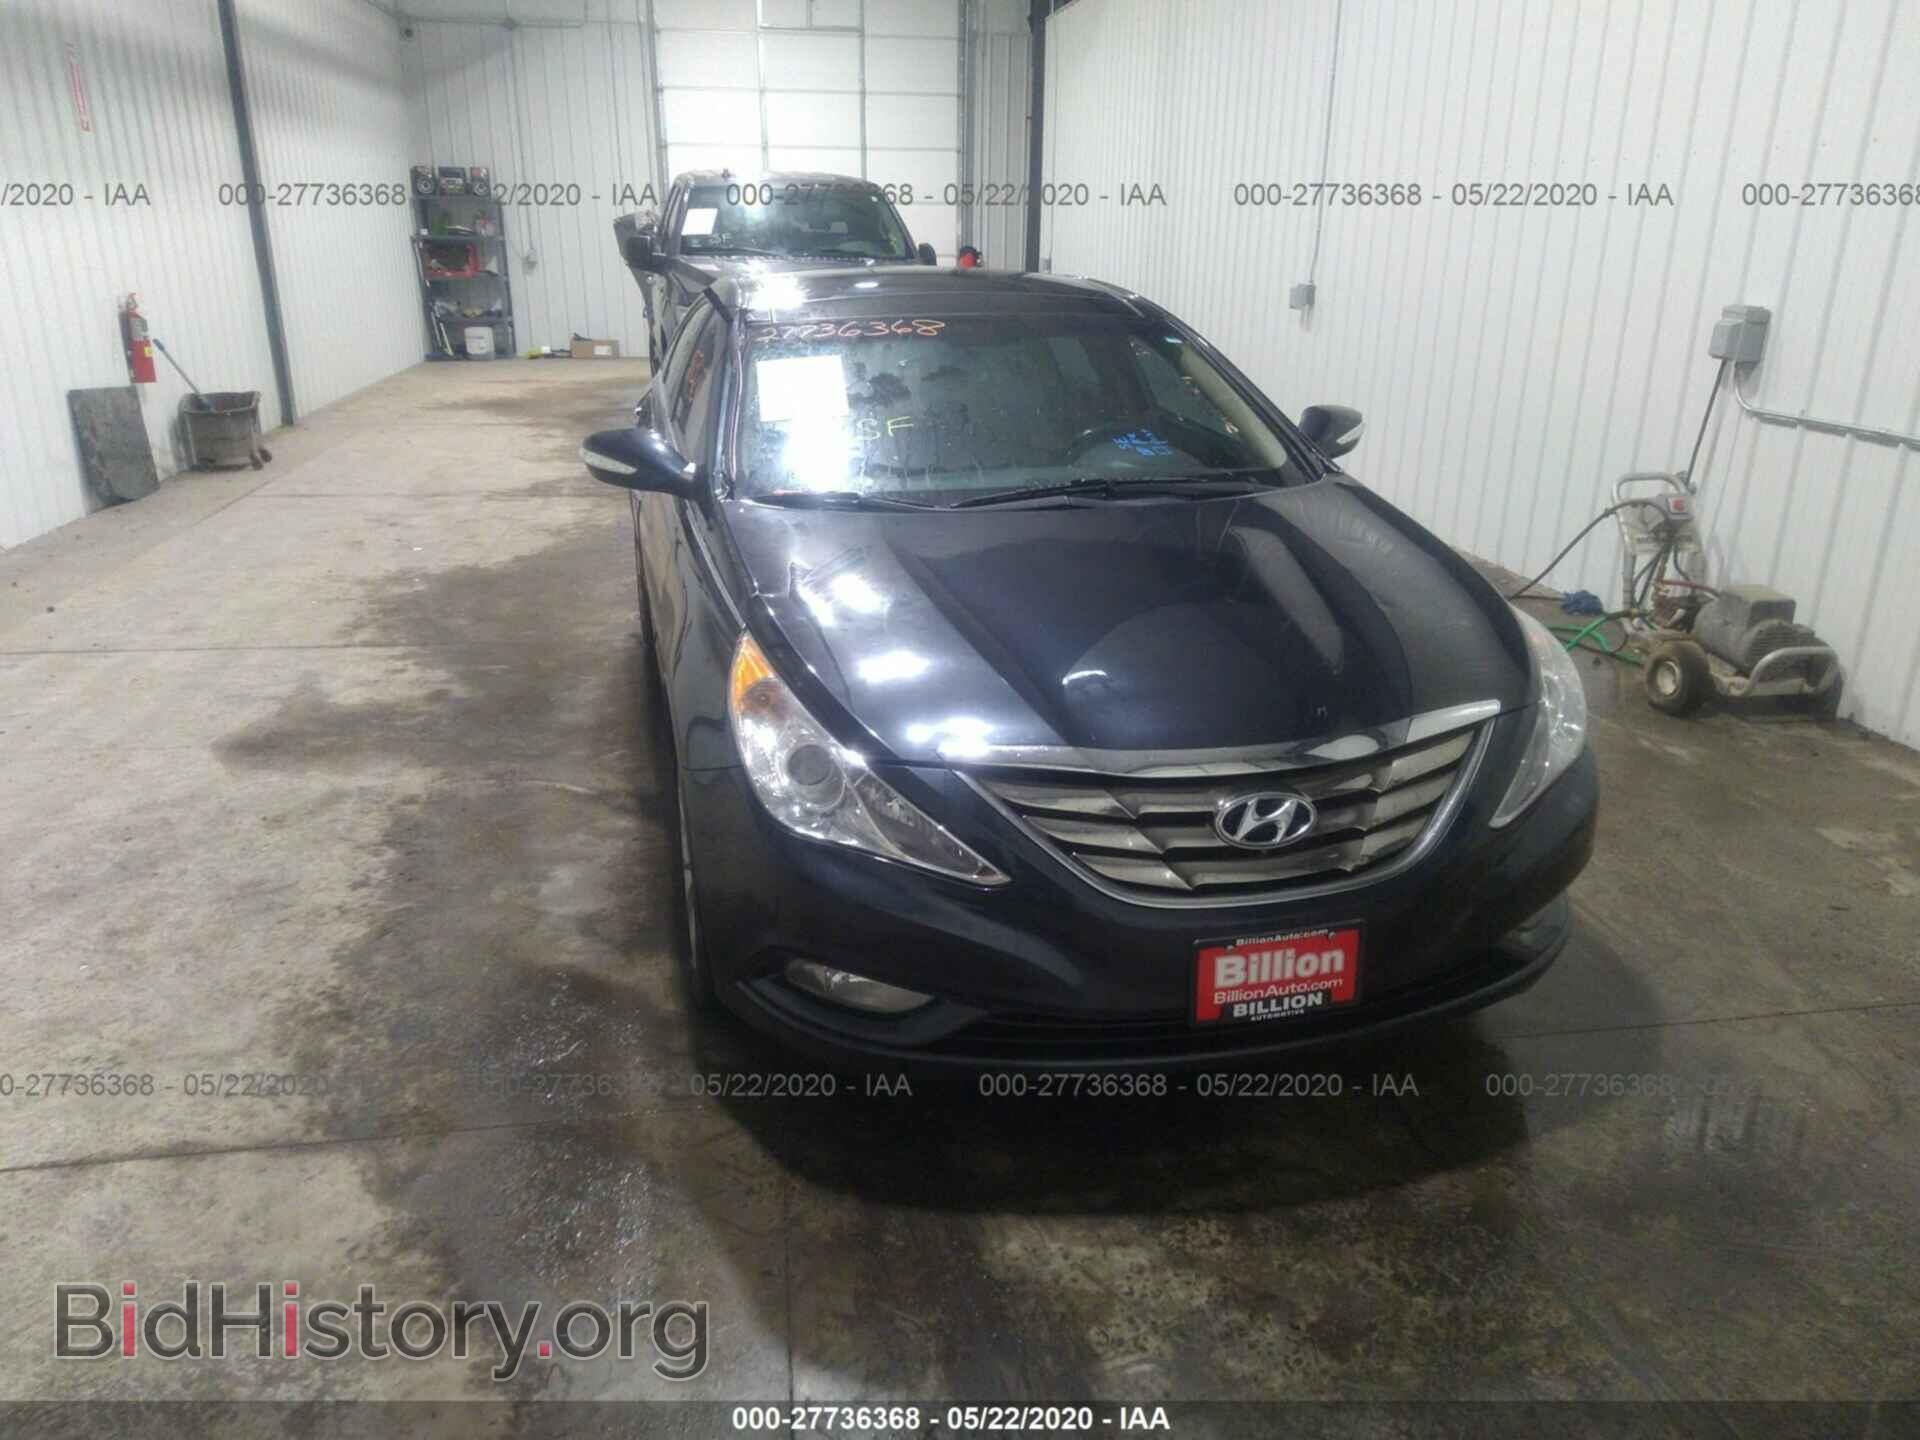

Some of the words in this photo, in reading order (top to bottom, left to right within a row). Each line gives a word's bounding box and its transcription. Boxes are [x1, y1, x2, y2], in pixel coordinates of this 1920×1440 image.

[1213, 946, 1346, 989] Billion
[1212, 977, 1344, 1005] BillionAuto.com
[1232, 991, 1324, 1018] BILLION
